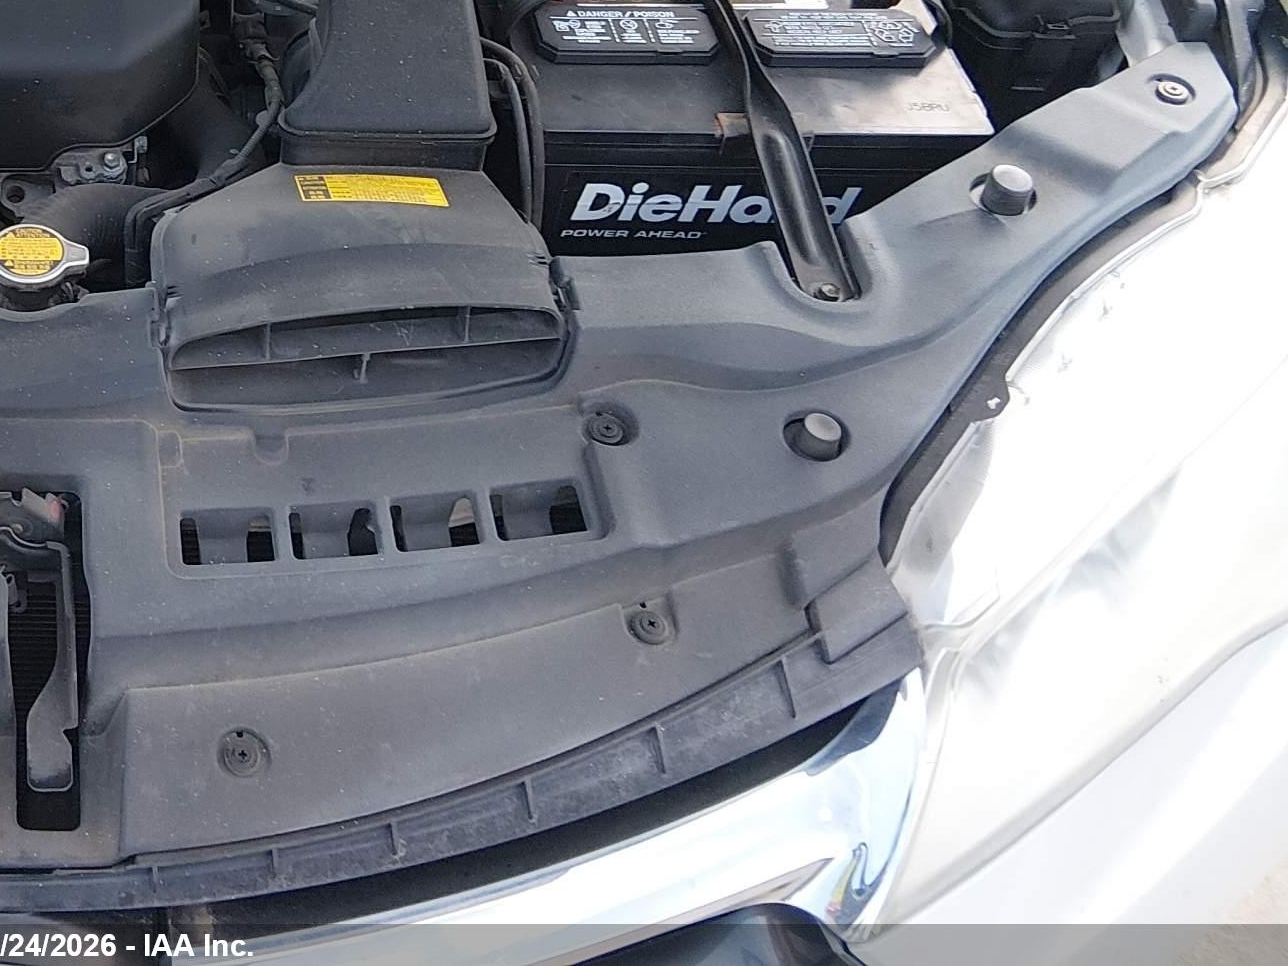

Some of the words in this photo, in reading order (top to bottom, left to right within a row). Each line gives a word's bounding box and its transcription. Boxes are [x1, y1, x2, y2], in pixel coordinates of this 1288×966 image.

[577, 10, 624, 18] DANGER
[633, 10, 676, 18] POISON
[569, 181, 863, 226] DieHad
[559, 229, 630, 238] POWER
[633, 230, 702, 239] AHEAD
